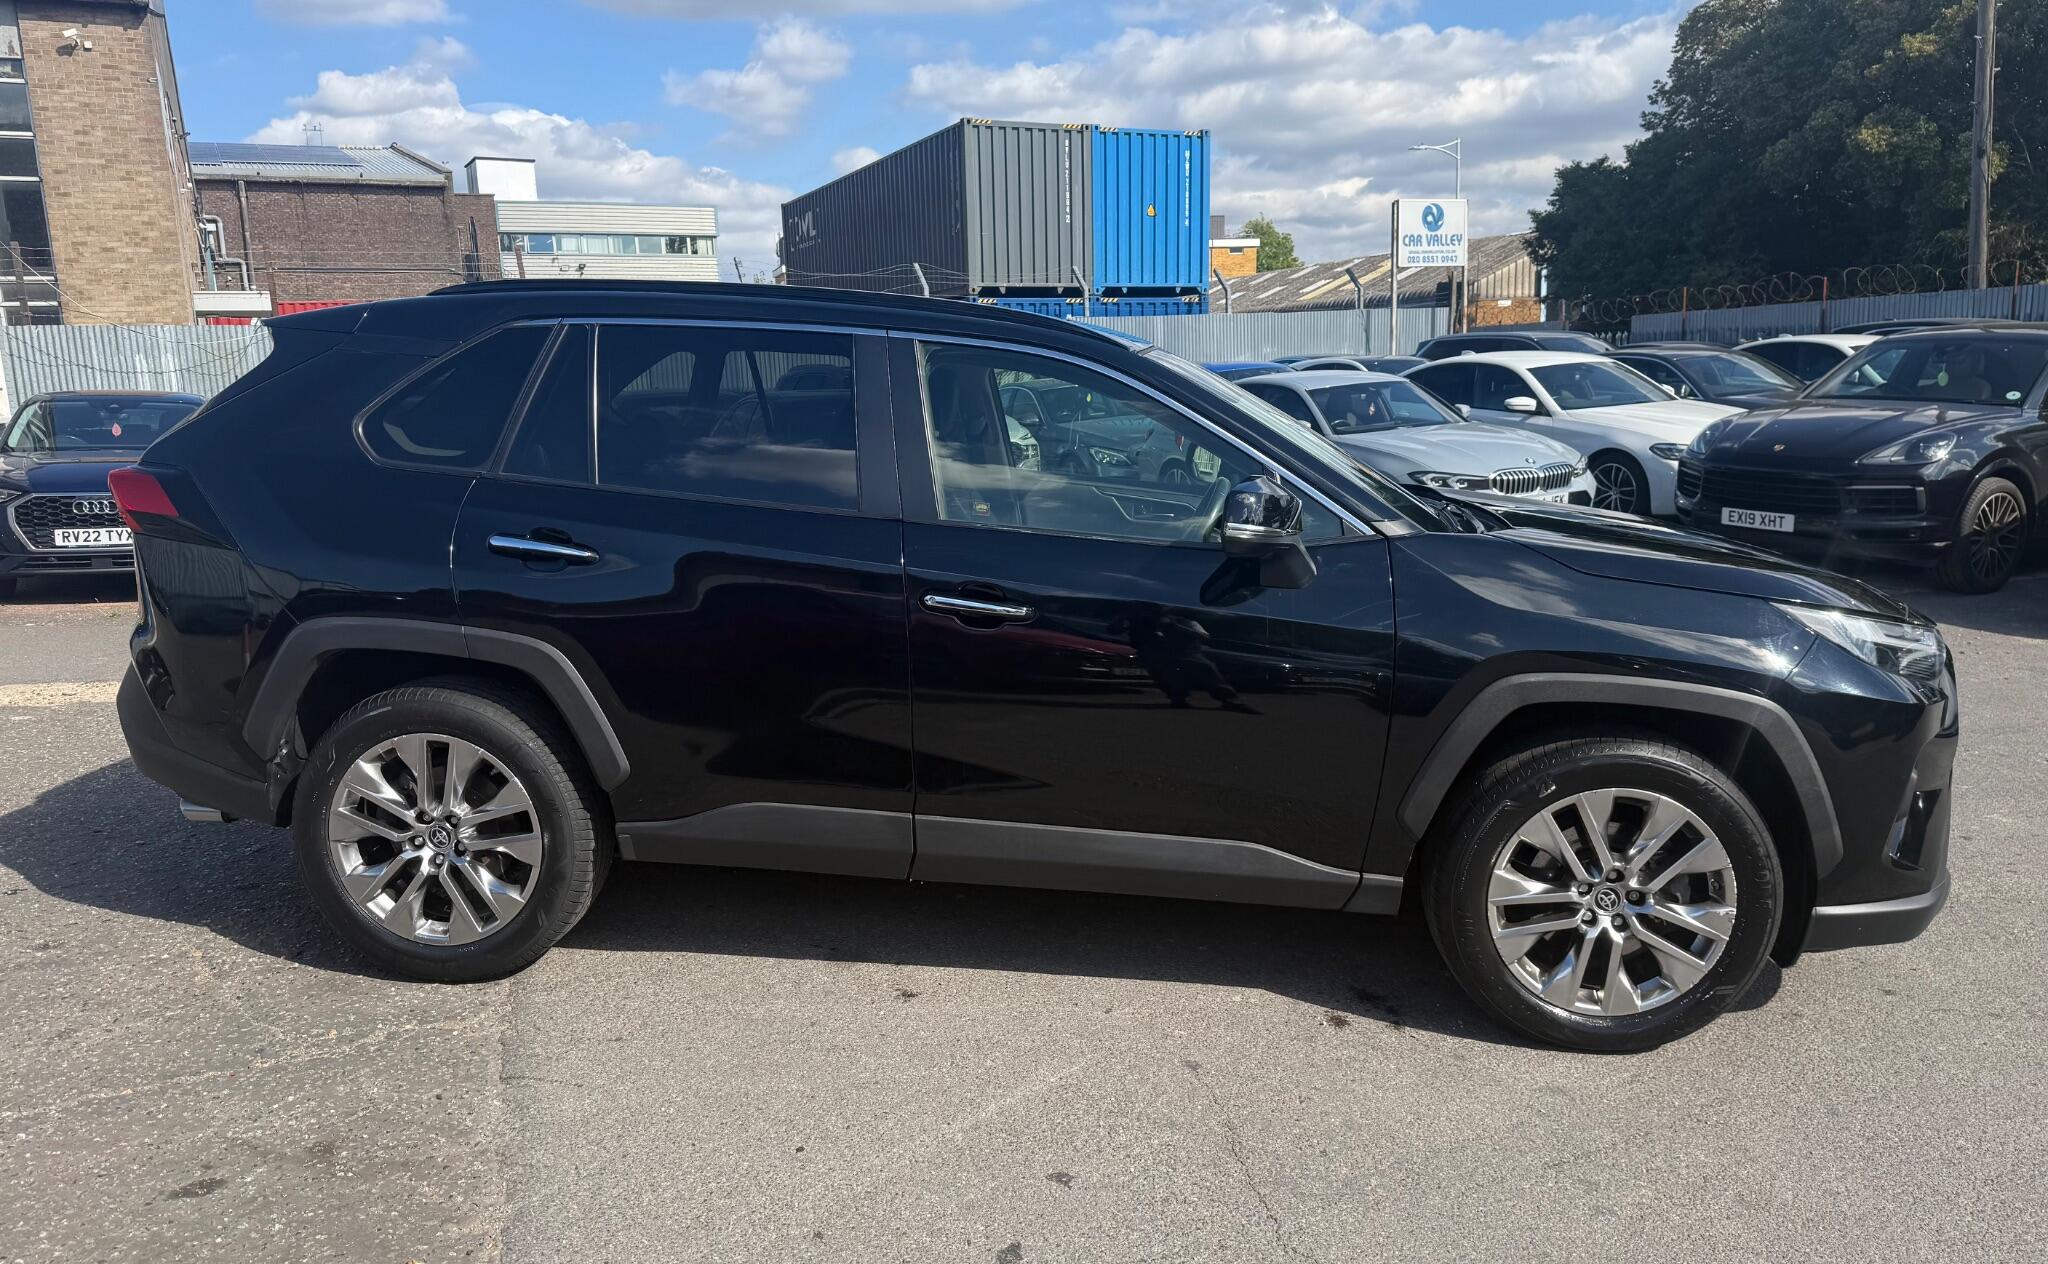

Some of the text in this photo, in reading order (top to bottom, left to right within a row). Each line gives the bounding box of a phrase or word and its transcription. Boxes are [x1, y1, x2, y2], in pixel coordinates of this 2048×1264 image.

[1402, 234, 1463, 247] CAR VALLEY
[1407, 255, 1458, 263] 020 8551 0947
[1728, 510, 1786, 528] EX19 XHT
[62, 529, 133, 543] RV22 TYX
